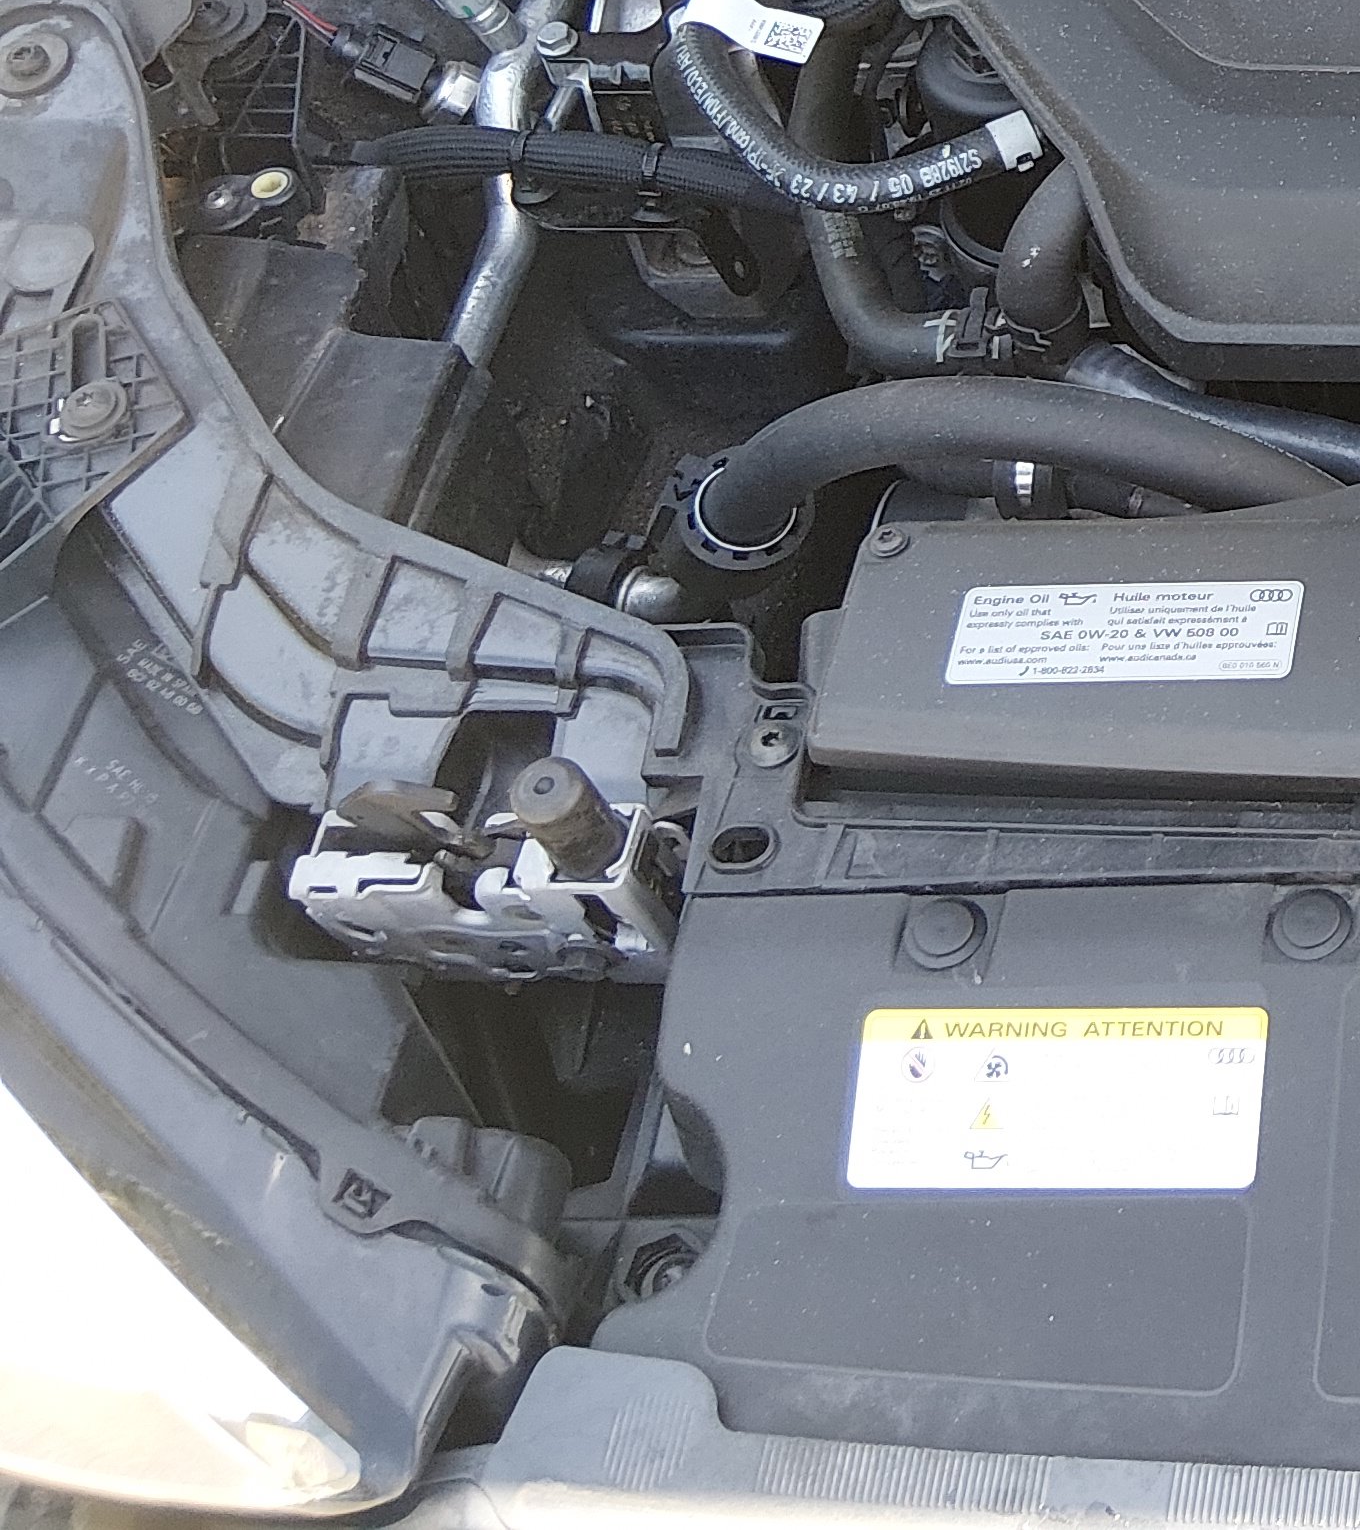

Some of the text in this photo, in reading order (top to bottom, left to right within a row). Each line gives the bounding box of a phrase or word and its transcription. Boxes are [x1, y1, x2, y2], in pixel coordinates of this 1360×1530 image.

[974, 594, 1050, 607] Engine Oil
[1113, 592, 1214, 602] Huile moteur
[969, 608, 1052, 618] Use only oil that
[1109, 606, 1145, 614] Utiliser
[1148, 605, 1209, 615] uniquement
[1211, 604, 1223, 612] de
[966, 619, 1014, 630] expressly
[1016, 619, 1059, 628] complies
[1107, 616, 1124, 626] qui
[1126, 616, 1166, 625] satisfait
[1168, 616, 1240, 625] expressément
[1040, 627, 1240, 640] SAE 0W-20 & VW 508 00
[960, 645, 976, 654] For
[988, 645, 1003, 653] list
[1006, 644, 1016, 653] of
[1018, 644, 1066, 654] approved
[1101, 642, 1126, 651] Pour
[1150, 642, 1171, 650] liste
[957, 656, 1048, 666] www.audiusa.com
[1099, 653, 1197, 663] www.audicanada.ca
[945, 1018, 1225, 1039] WARNING ATTENTION
